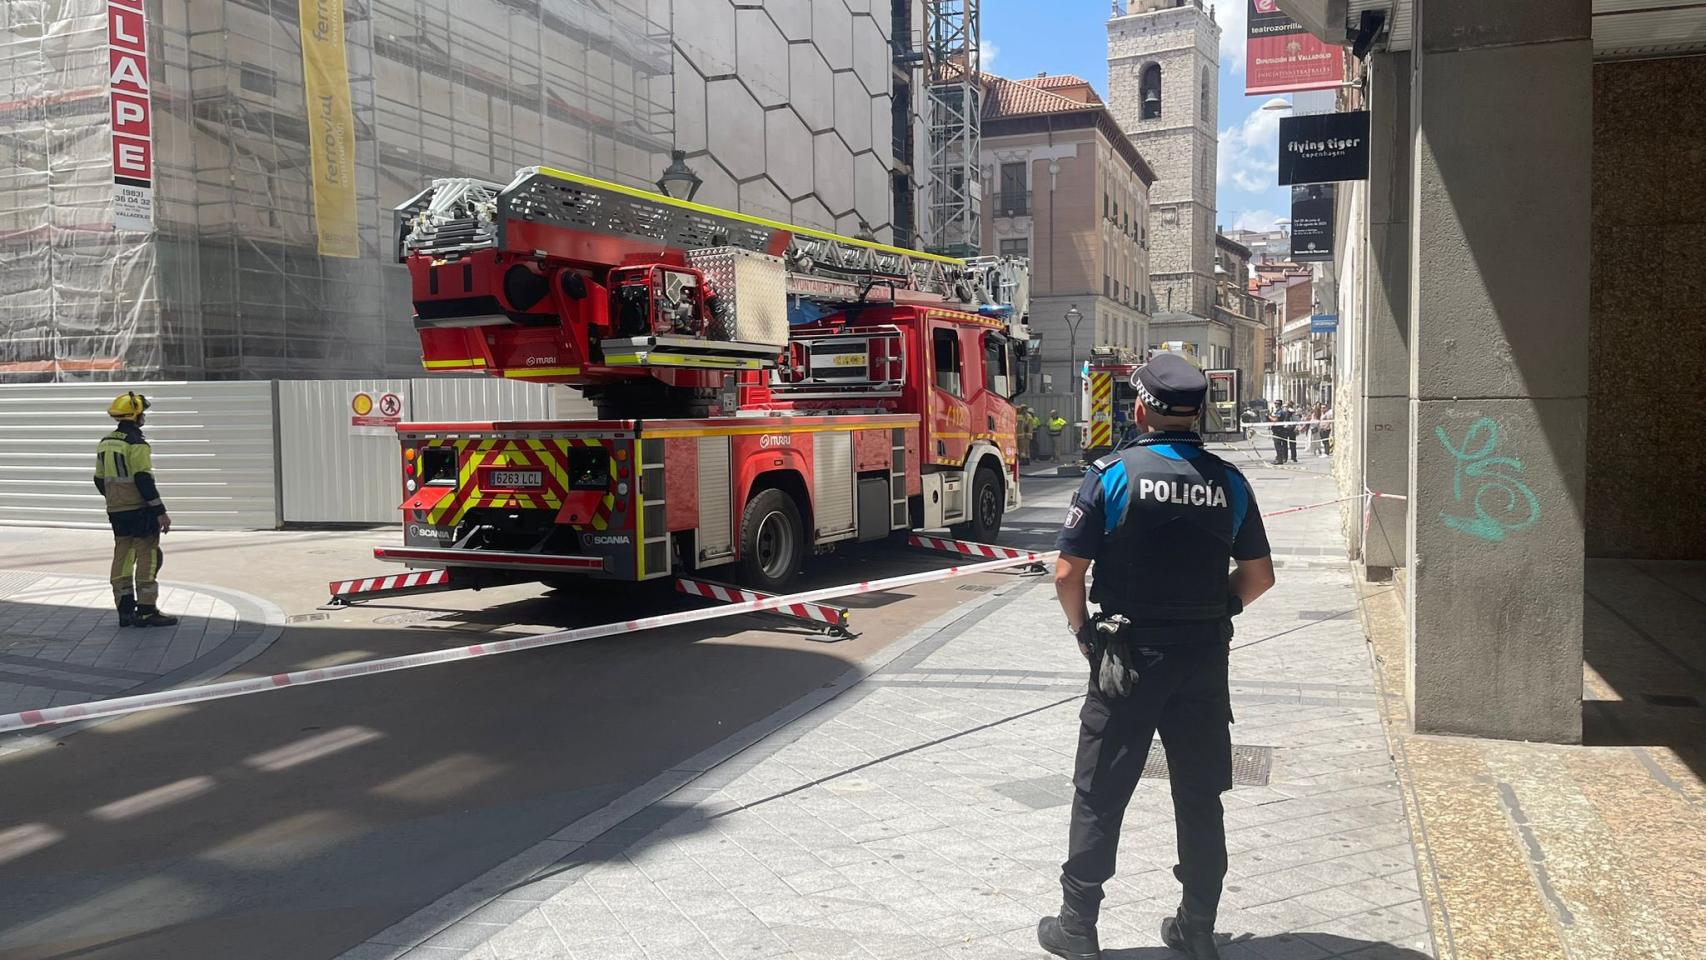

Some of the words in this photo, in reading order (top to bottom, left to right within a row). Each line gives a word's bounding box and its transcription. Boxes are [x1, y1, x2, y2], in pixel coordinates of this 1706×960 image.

[111, 0, 149, 171] LAPE
[317, 95, 339, 185] ferrovial
[1288, 140, 1325, 153] flying
[1327, 138, 1360, 150] tiger
[496, 473, 520, 485] 6263
[522, 473, 540, 485] LCL
[1139, 478, 1228, 508] POLICÍA
[419, 528, 450, 538] SCANIA
[594, 535, 630, 545] SCANIA
